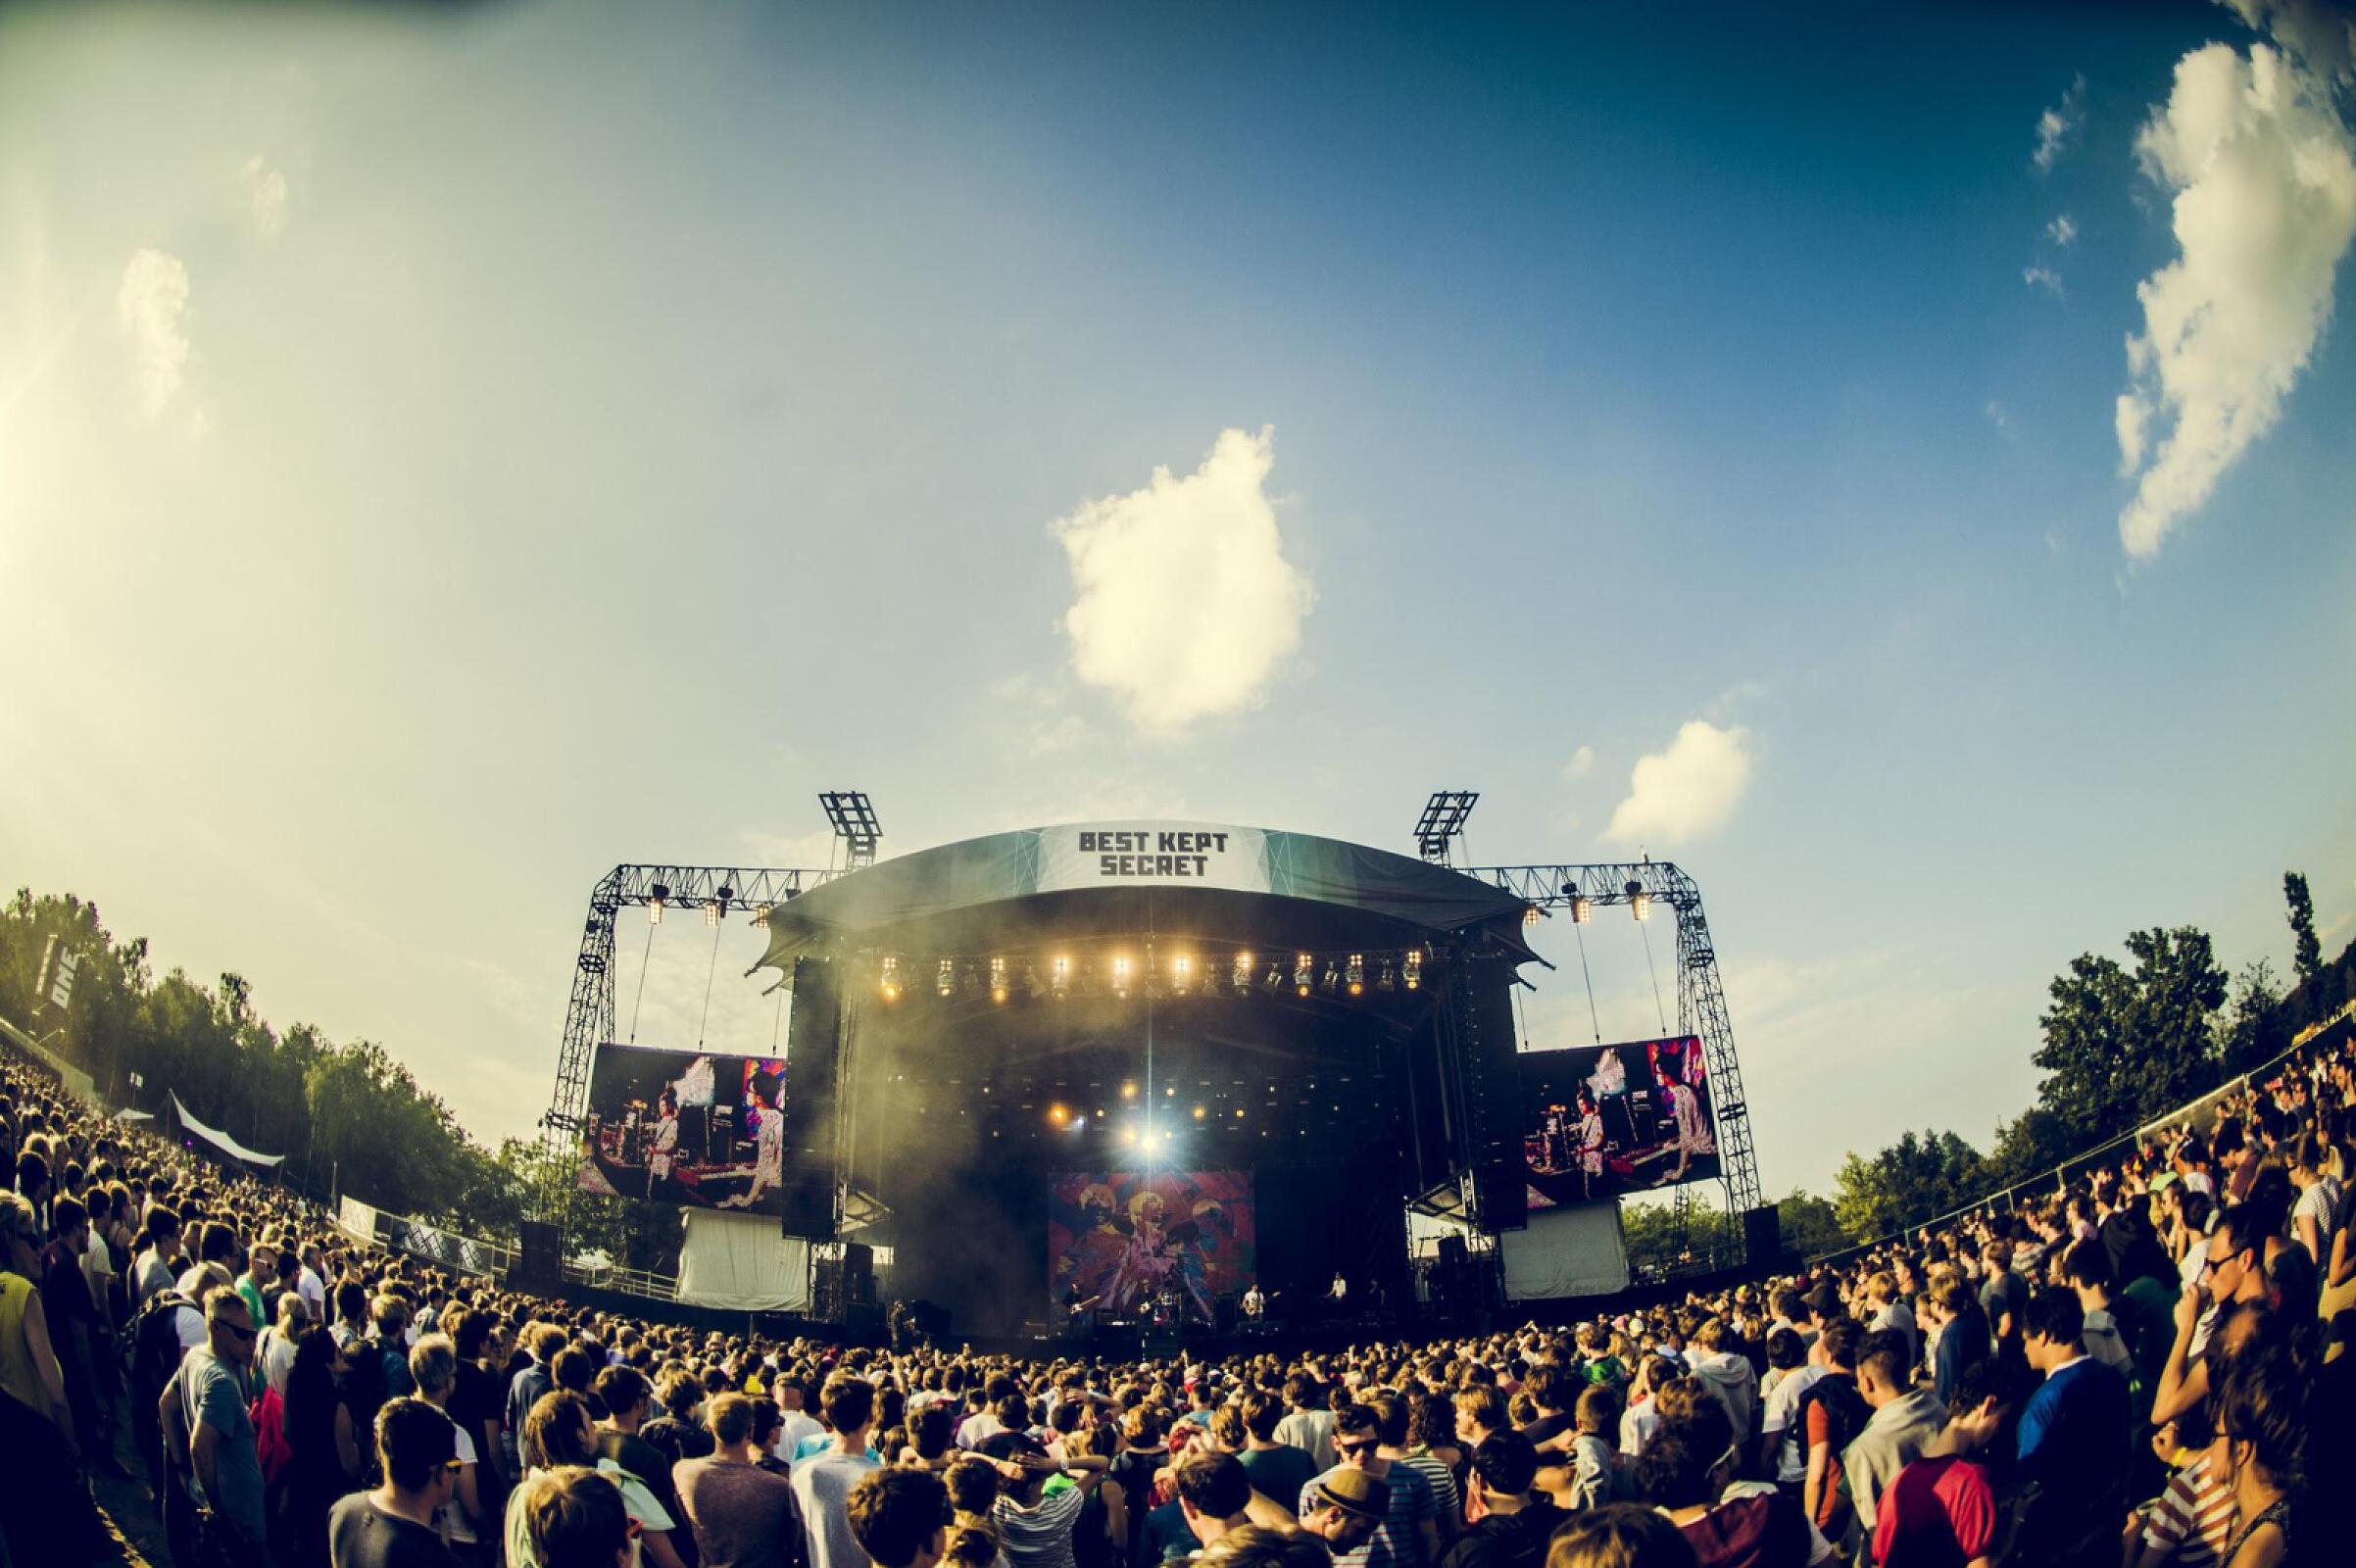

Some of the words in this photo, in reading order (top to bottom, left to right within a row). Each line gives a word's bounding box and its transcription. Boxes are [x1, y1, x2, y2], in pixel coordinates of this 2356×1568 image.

[1080, 832, 1150, 852] BEST
[1158, 832, 1229, 853] KEPT
[1101, 855, 1208, 876] SECRET
